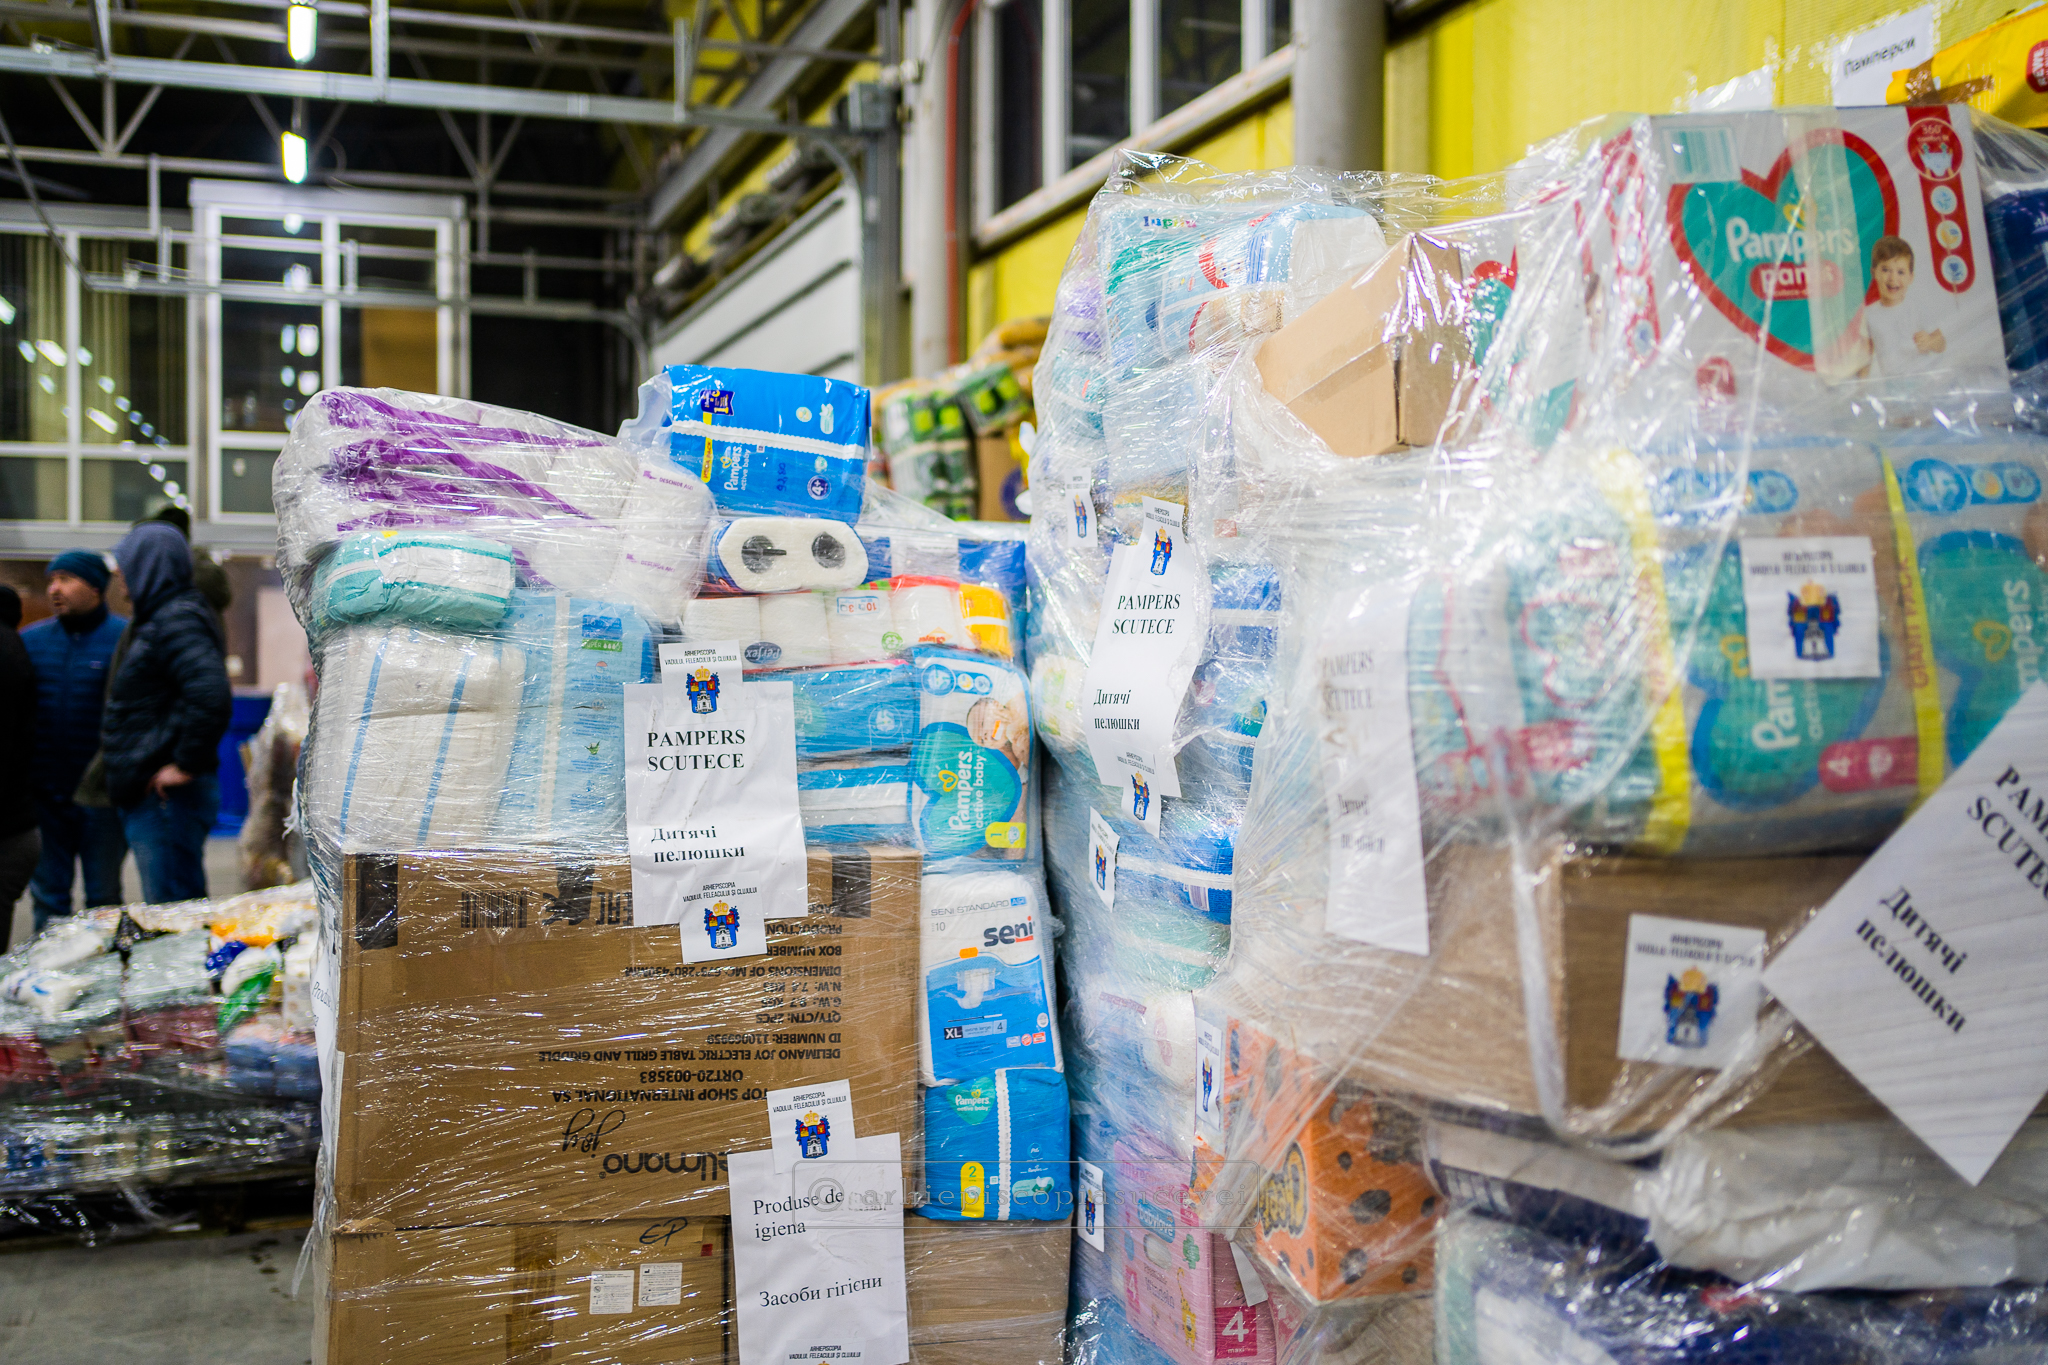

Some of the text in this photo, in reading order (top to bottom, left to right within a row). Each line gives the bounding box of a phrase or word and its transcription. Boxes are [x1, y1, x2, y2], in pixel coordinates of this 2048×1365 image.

[1725, 216, 1855, 265] Pampers
[1760, 264, 1836, 294] pans
[723, 445, 742, 491] Pampers
[742, 448, 751, 470] baby
[811, 479, 824, 496] 4+
[866, 602, 877, 612] 10
[1117, 593, 1181, 611] PAMPERS
[1112, 618, 1175, 635] SCUTECE
[2002, 579, 2046, 690] mpers
[744, 645, 781, 661] Perfex
[1093, 689, 1132, 706] Дитячі
[1751, 678, 1801, 750] Pam
[1094, 717, 1140, 731] пелюшки
[647, 729, 746, 748] PAMPERS
[647, 753, 745, 772] SCUTECE
[948, 751, 972, 830] Pampers
[972, 754, 987, 828] active baby
[1995, 764, 2048, 843] PAM
[651, 825, 717, 843] Дитячі
[654, 846, 745, 863] пелюшки
[1967, 794, 2048, 901] SCUTE
[930, 907, 955, 917] SENI
[956, 899, 1010, 914] STANDARD
[766, 924, 843, 935] PRODUCTION
[935, 922, 946, 932] 10
[983, 915, 1034, 947] seni
[1878, 885, 1968, 975] Дитячі
[766, 945, 842, 957] BOX NUMBER
[749, 965, 765, 977] OF
[767, 965, 842, 977] DIMENSIONS
[1855, 918, 1966, 1034] пелюшки
[813, 981, 842, 992] N.W:
[755, 1012, 842, 1025] QTY/CTN: 2PCS
[772, 1033, 827, 1045] NUMBER:
[828, 1033, 842, 1044] ID
[945, 1027, 963, 1040] XL
[997, 1022, 1003, 1031] 4
[538, 1048, 841, 1062] DELIMANO JOY ELECTRIC TABLE GRILL AND GRIDDLE
[639, 1069, 744, 1084] ORT20-003583
[552, 1087, 768, 1103] TOP SHOP INTERNATIONAL SA
[955, 1094, 991, 1107] Pampers
[603, 1152, 728, 1181] elimano
[968, 1166, 977, 1178] 2
[753, 1188, 844, 1216] Produse de
[755, 1220, 807, 1243] igiena
[759, 1277, 883, 1308] Засоби гігієни
[1220, 1311, 1250, 1343] 4
